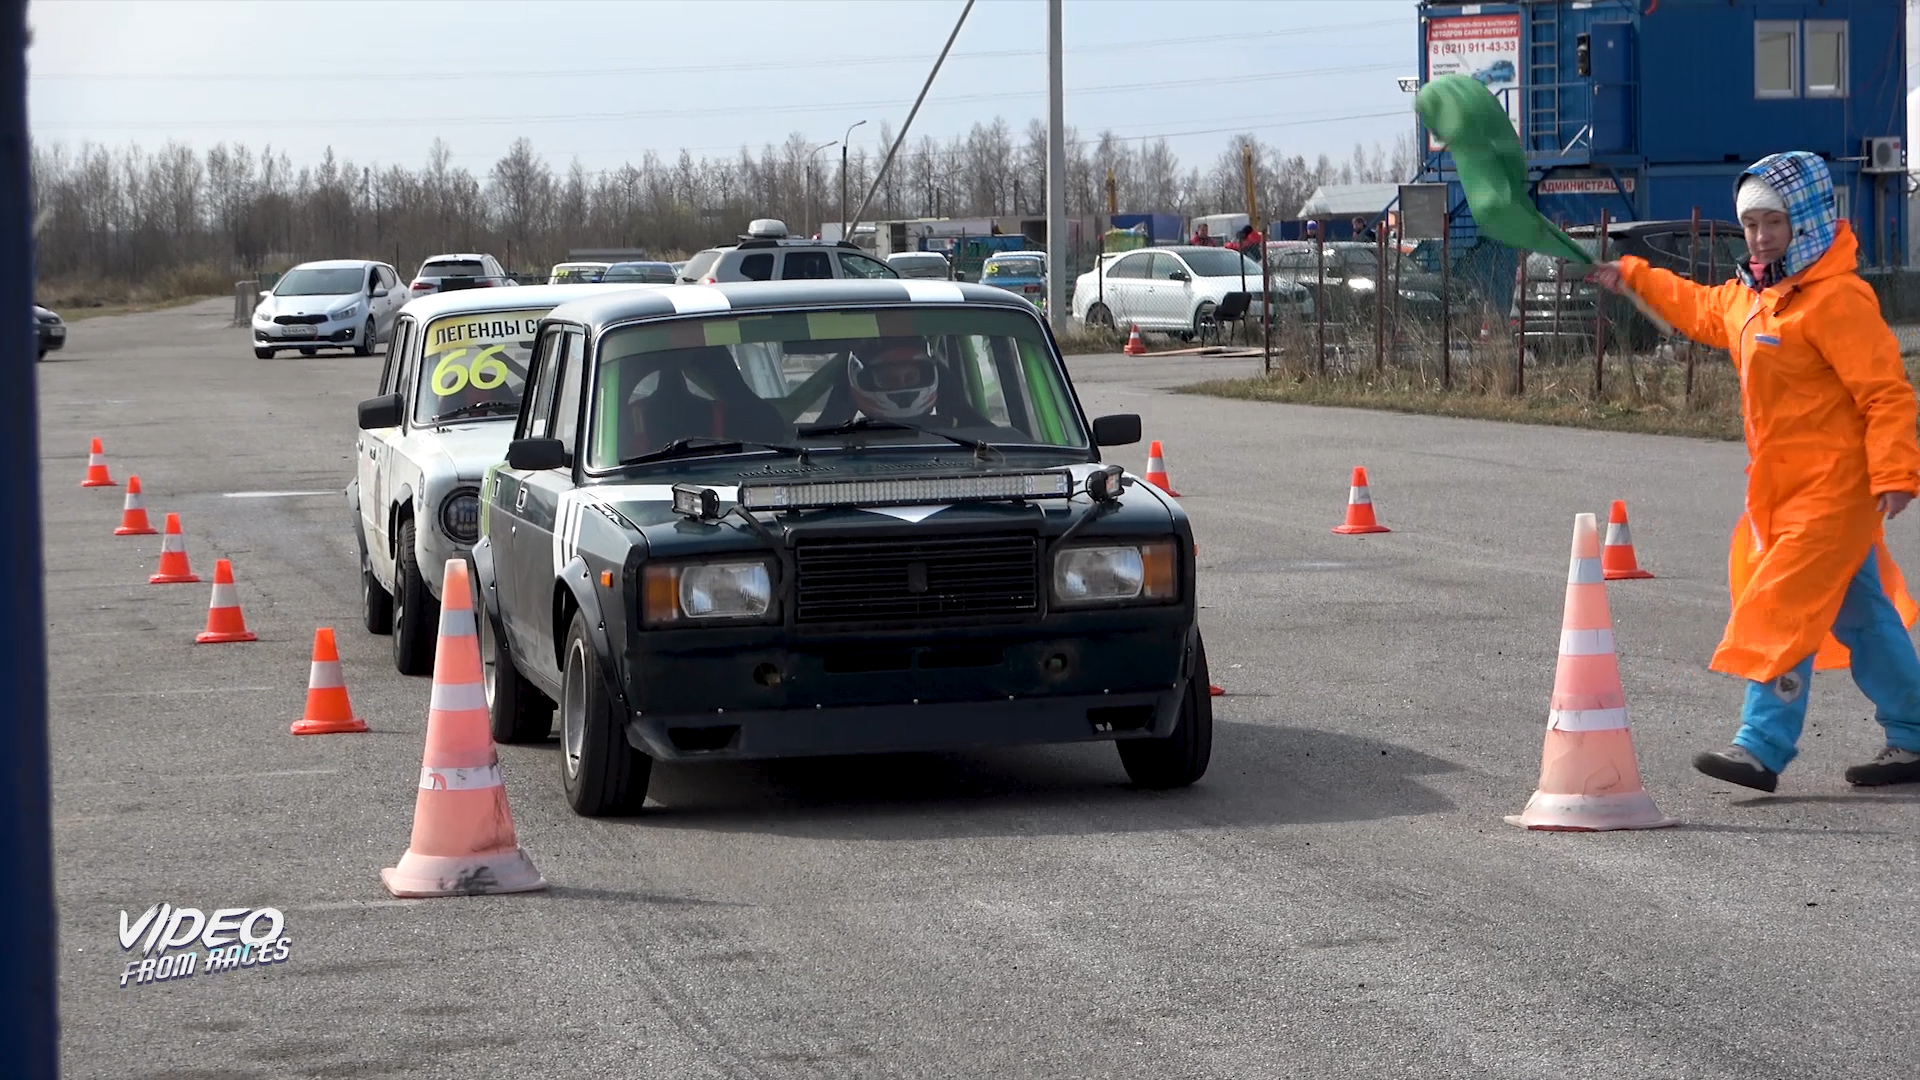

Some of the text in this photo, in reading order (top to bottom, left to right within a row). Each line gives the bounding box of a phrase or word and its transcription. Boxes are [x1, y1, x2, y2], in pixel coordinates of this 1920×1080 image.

[1431, 27, 1518, 38] АВТОДРОМ САНКТ-ПЕТЕРБУРГ
[1433, 40, 1516, 56] 8 (921) 911-43-33
[1541, 180, 1633, 194] АДМИНИСТРАЦЯ
[435, 320, 520, 346] ЛЕГЕНДЫ
[431, 344, 508, 396] 66
